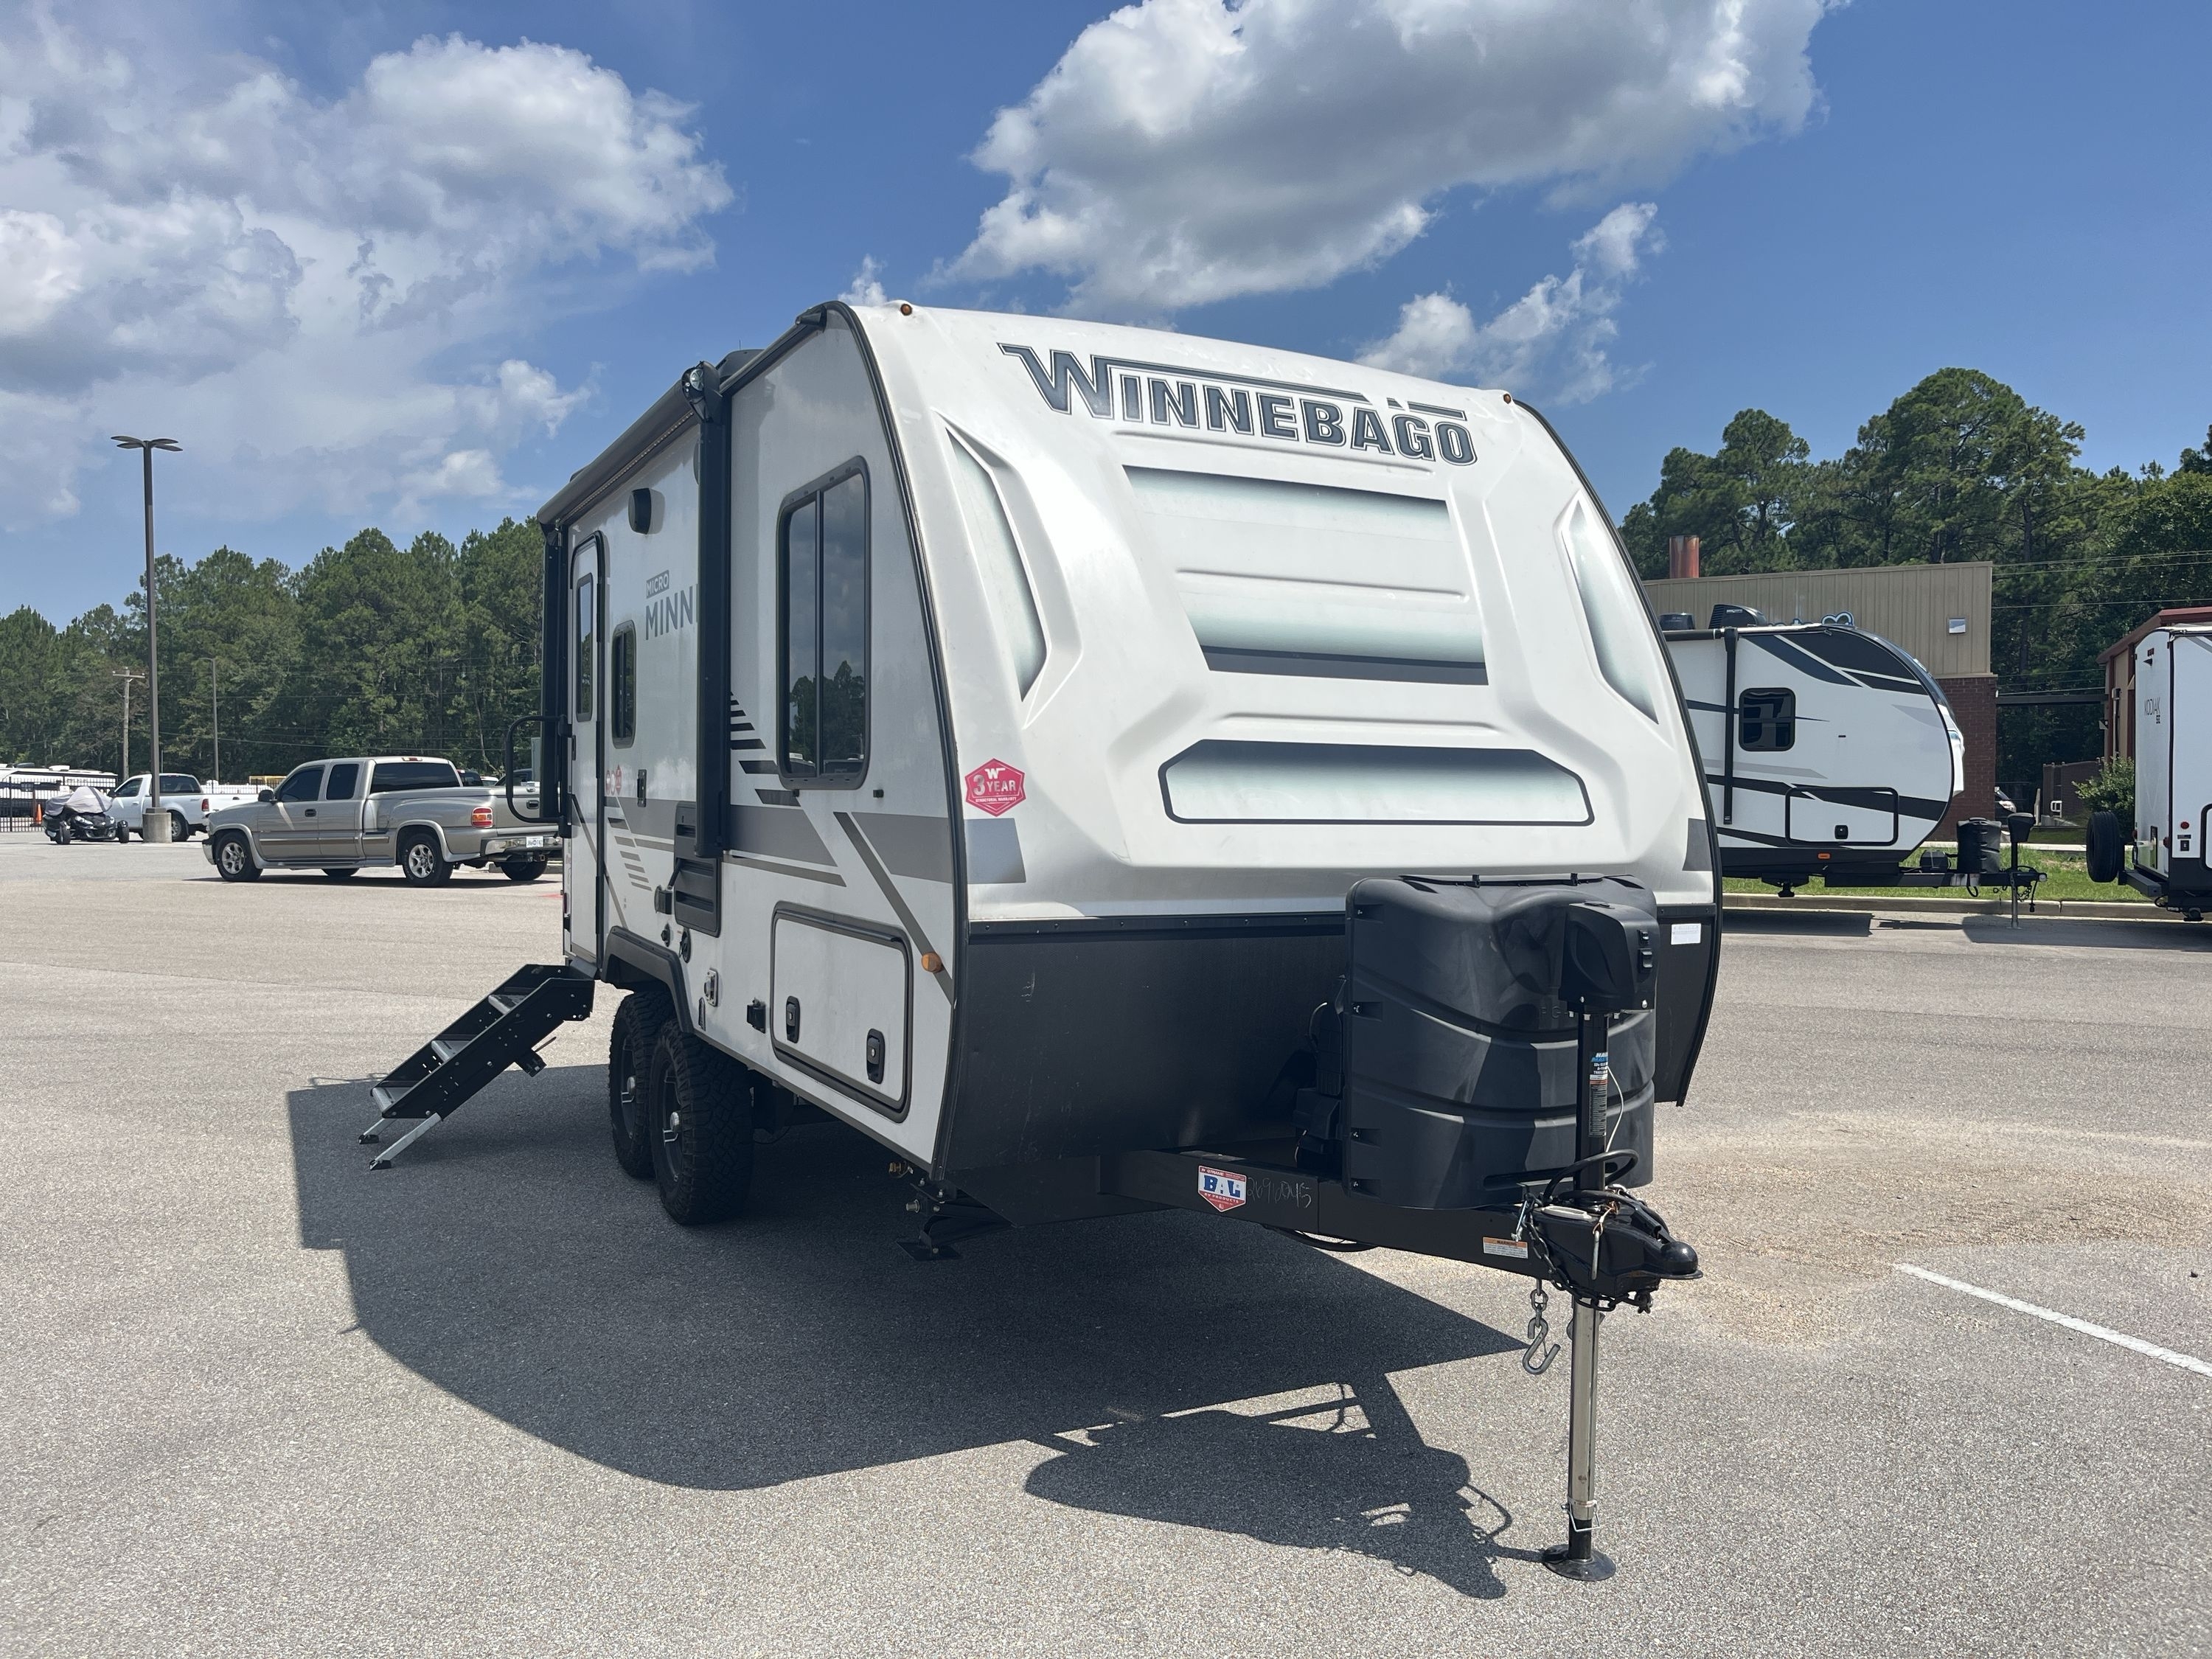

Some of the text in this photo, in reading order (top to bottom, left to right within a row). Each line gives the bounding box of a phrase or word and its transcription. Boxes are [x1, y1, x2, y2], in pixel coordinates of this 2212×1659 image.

[996, 342, 1478, 466] WINNEBAGO
[647, 573, 669, 597] MICRO
[2144, 697, 2160, 716] KODIAK
[973, 774, 1016, 796] 3 YEAR
[1204, 1175, 1241, 1198] BAL
[1212, 1194, 1239, 1203] PRODUCTS
